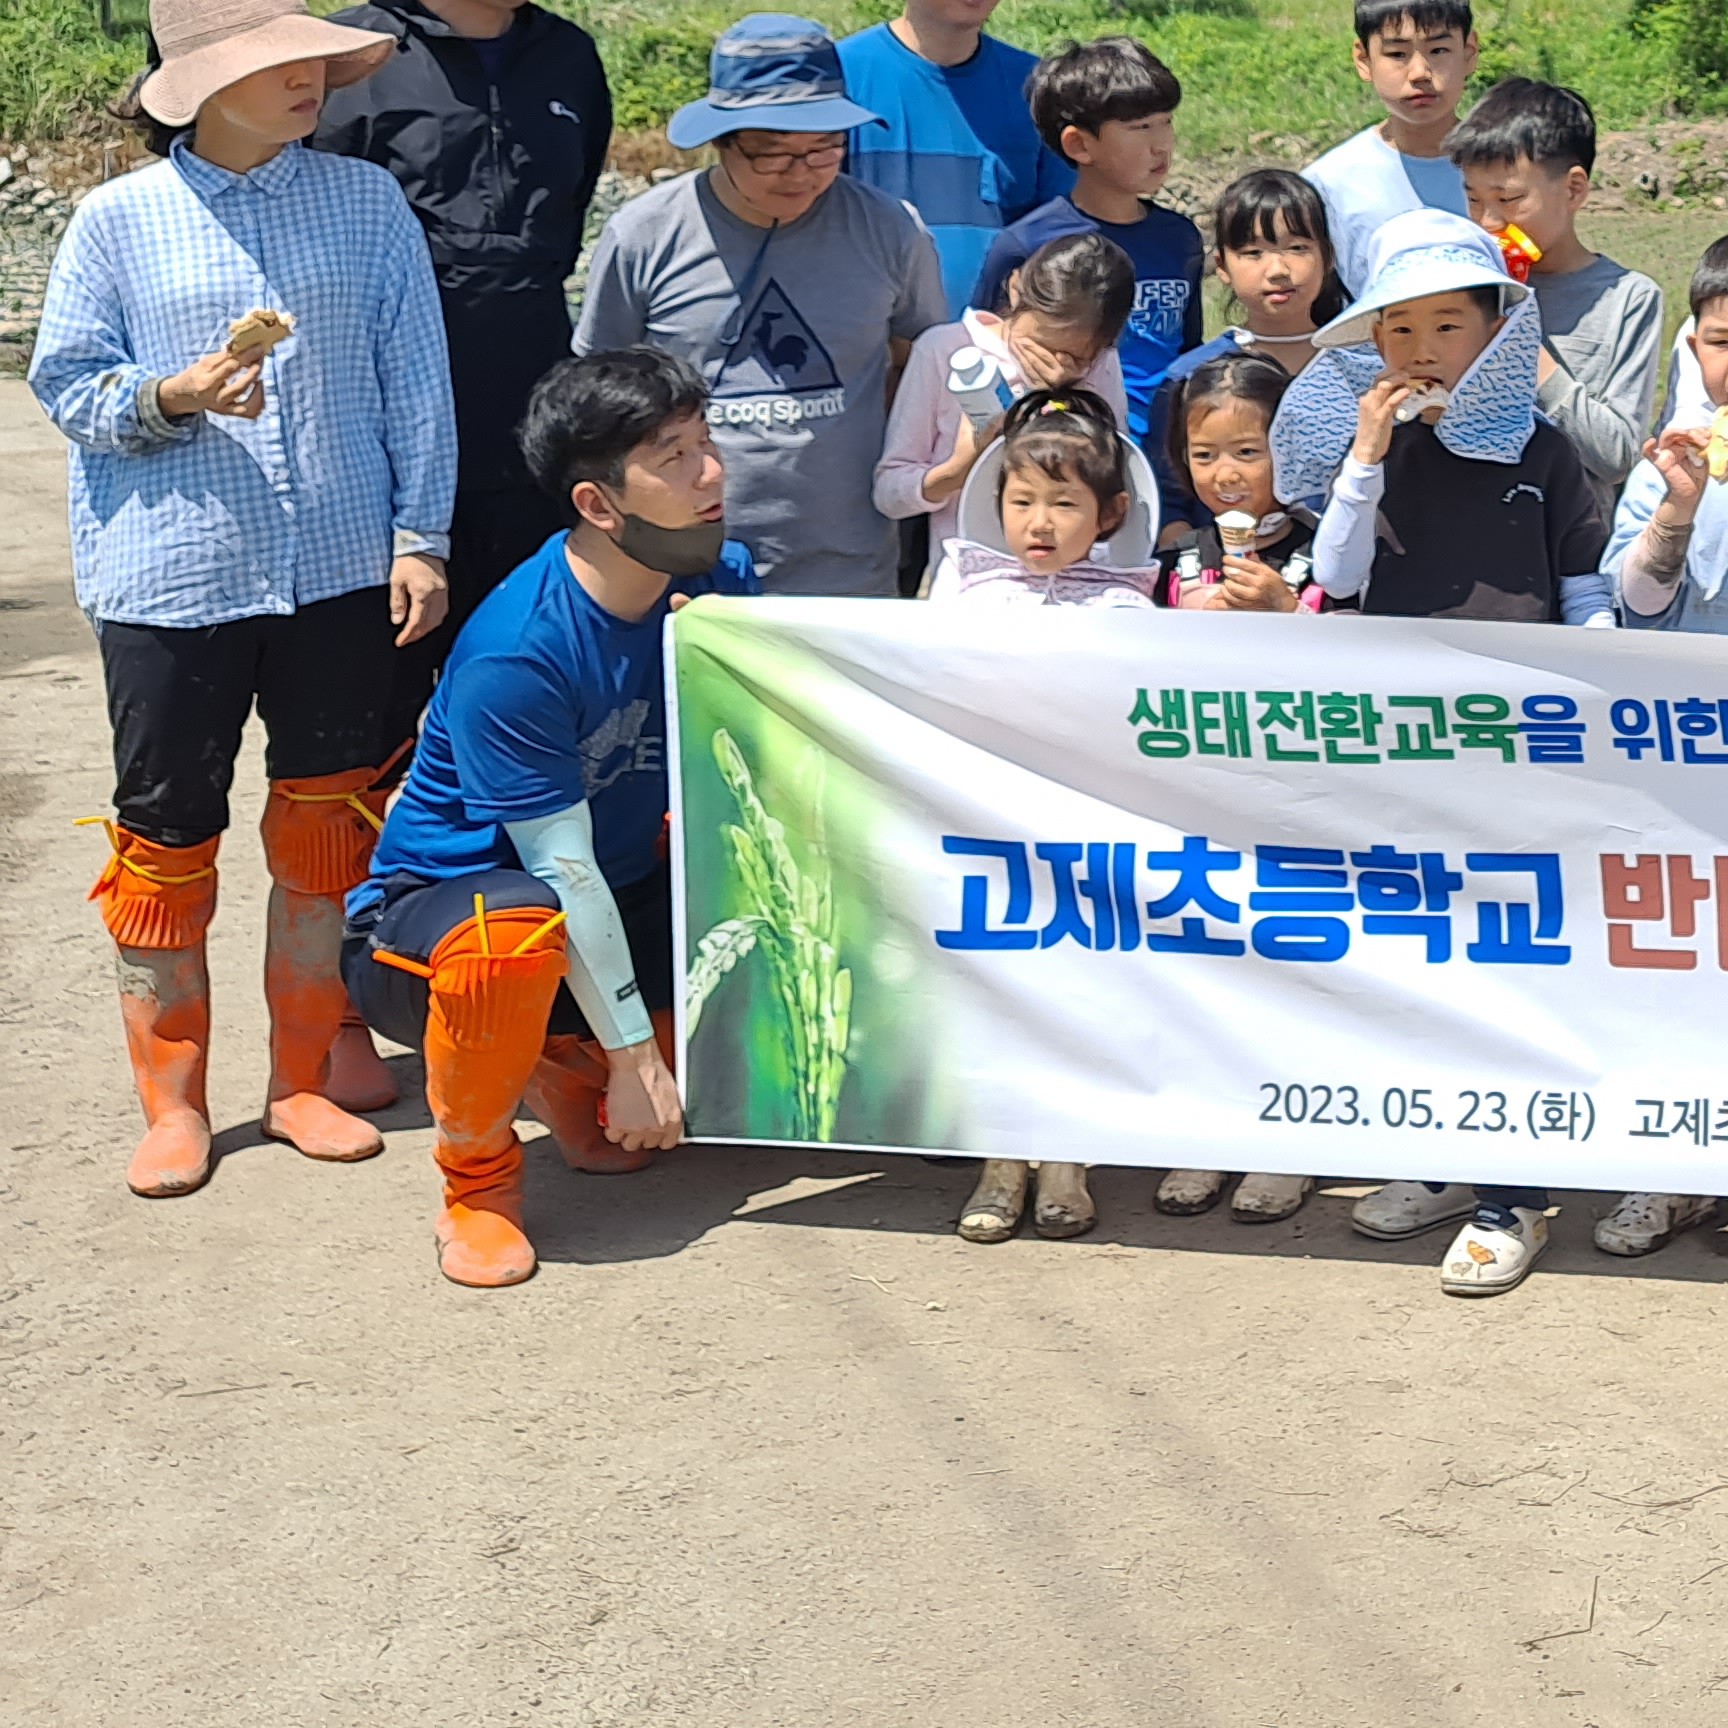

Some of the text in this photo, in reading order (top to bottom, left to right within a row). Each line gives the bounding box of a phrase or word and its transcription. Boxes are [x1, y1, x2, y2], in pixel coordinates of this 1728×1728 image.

[725, 401, 771, 427] coq
[1126, 687, 1586, 764] 생태전환교육을
[934, 834, 1572, 966] 고제초등학교
